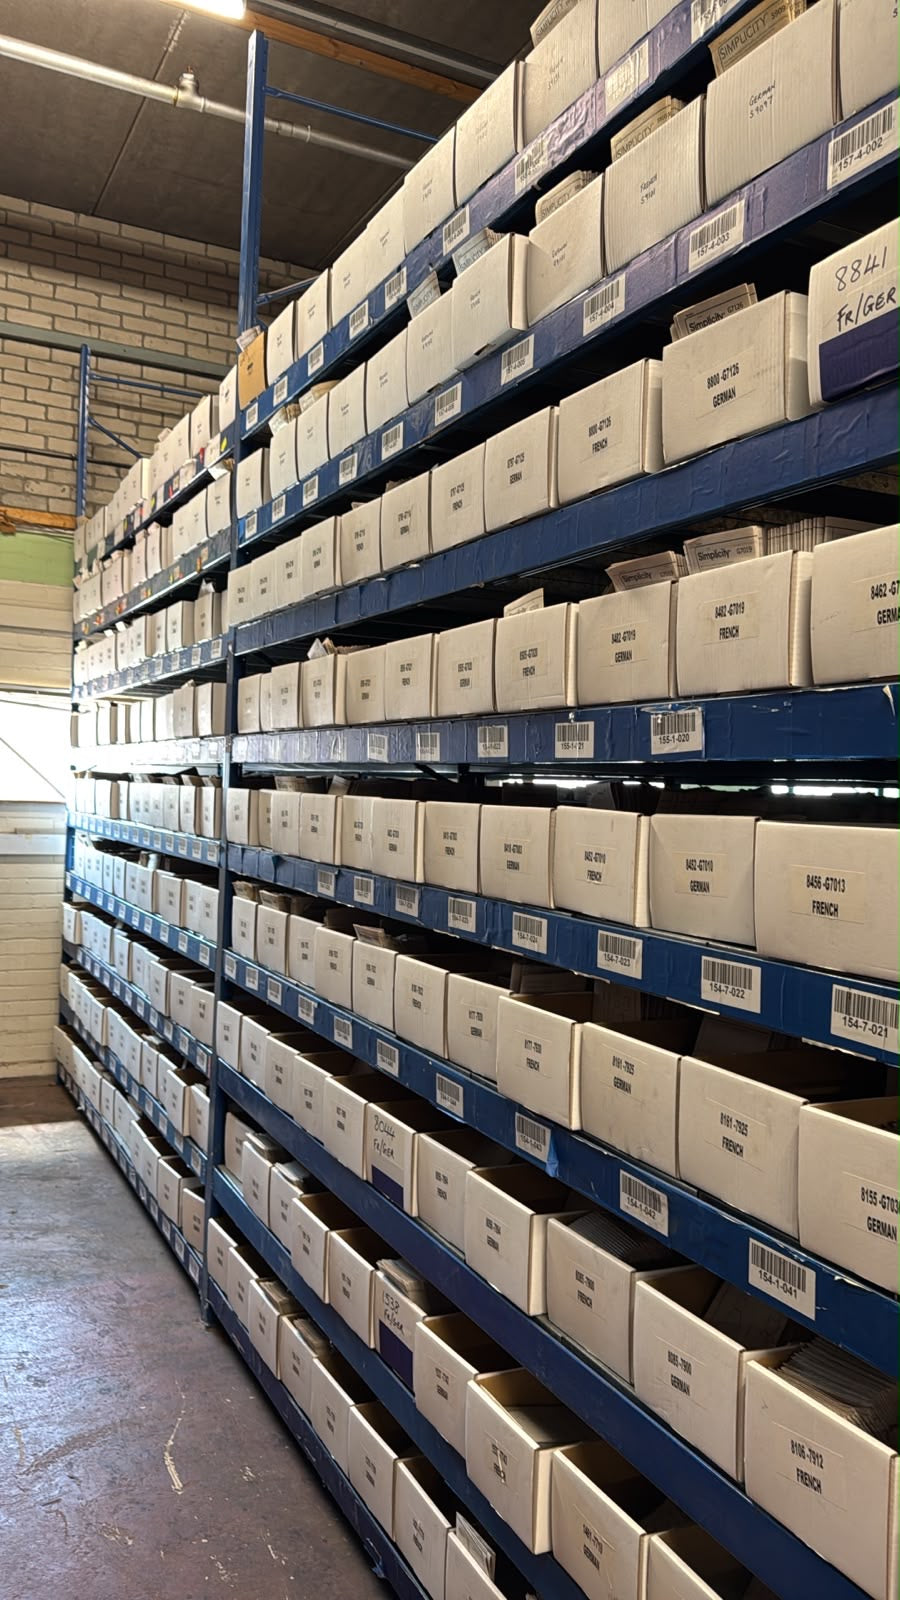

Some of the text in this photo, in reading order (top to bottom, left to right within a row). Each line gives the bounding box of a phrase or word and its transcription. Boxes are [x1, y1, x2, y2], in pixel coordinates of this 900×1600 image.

[720, 13, 768, 60] SIMPLICITY
[838, 138, 883, 171] 157-4-002
[697, 233, 730, 258] 157-4-003
[835, 246, 887, 292] 8841
[836, 287, 896, 332] FR/GER
[707, 375, 720, 389] 8800
[713, 386, 736, 407] GERMAN
[592, 438, 608, 453] FRENCH
[697, 548, 730, 563] Simplicity
[871, 583, 887, 599] 8462
[719, 625, 739, 640] FRENCH
[614, 650, 633, 663] GERMAN
[659, 734, 690, 745] 155-1-020
[587, 870, 602, 883] FRENCH
[806, 875, 821, 889] 8456
[690, 880, 710, 894] GERMAN
[812, 900, 839, 918] FRENCH
[604, 953, 631, 967] 154-7-023
[709, 982, 745, 999] 154-7-022
[842, 1016, 888, 1038] 154-7-021
[613, 1076, 631, 1094] GERMAN
[722, 1136, 744, 1157] FRENCH
[861, 1187, 877, 1206] 8155
[627, 1196, 656, 1220] 154-1-042
[867, 1217, 897, 1240] GERMAN
[758, 1270, 798, 1299] 154-1-041
[577, 1289, 593, 1309] FRENCH
[670, 1373, 690, 1396] GERMAN
[796, 1467, 822, 1494] FRENCH
